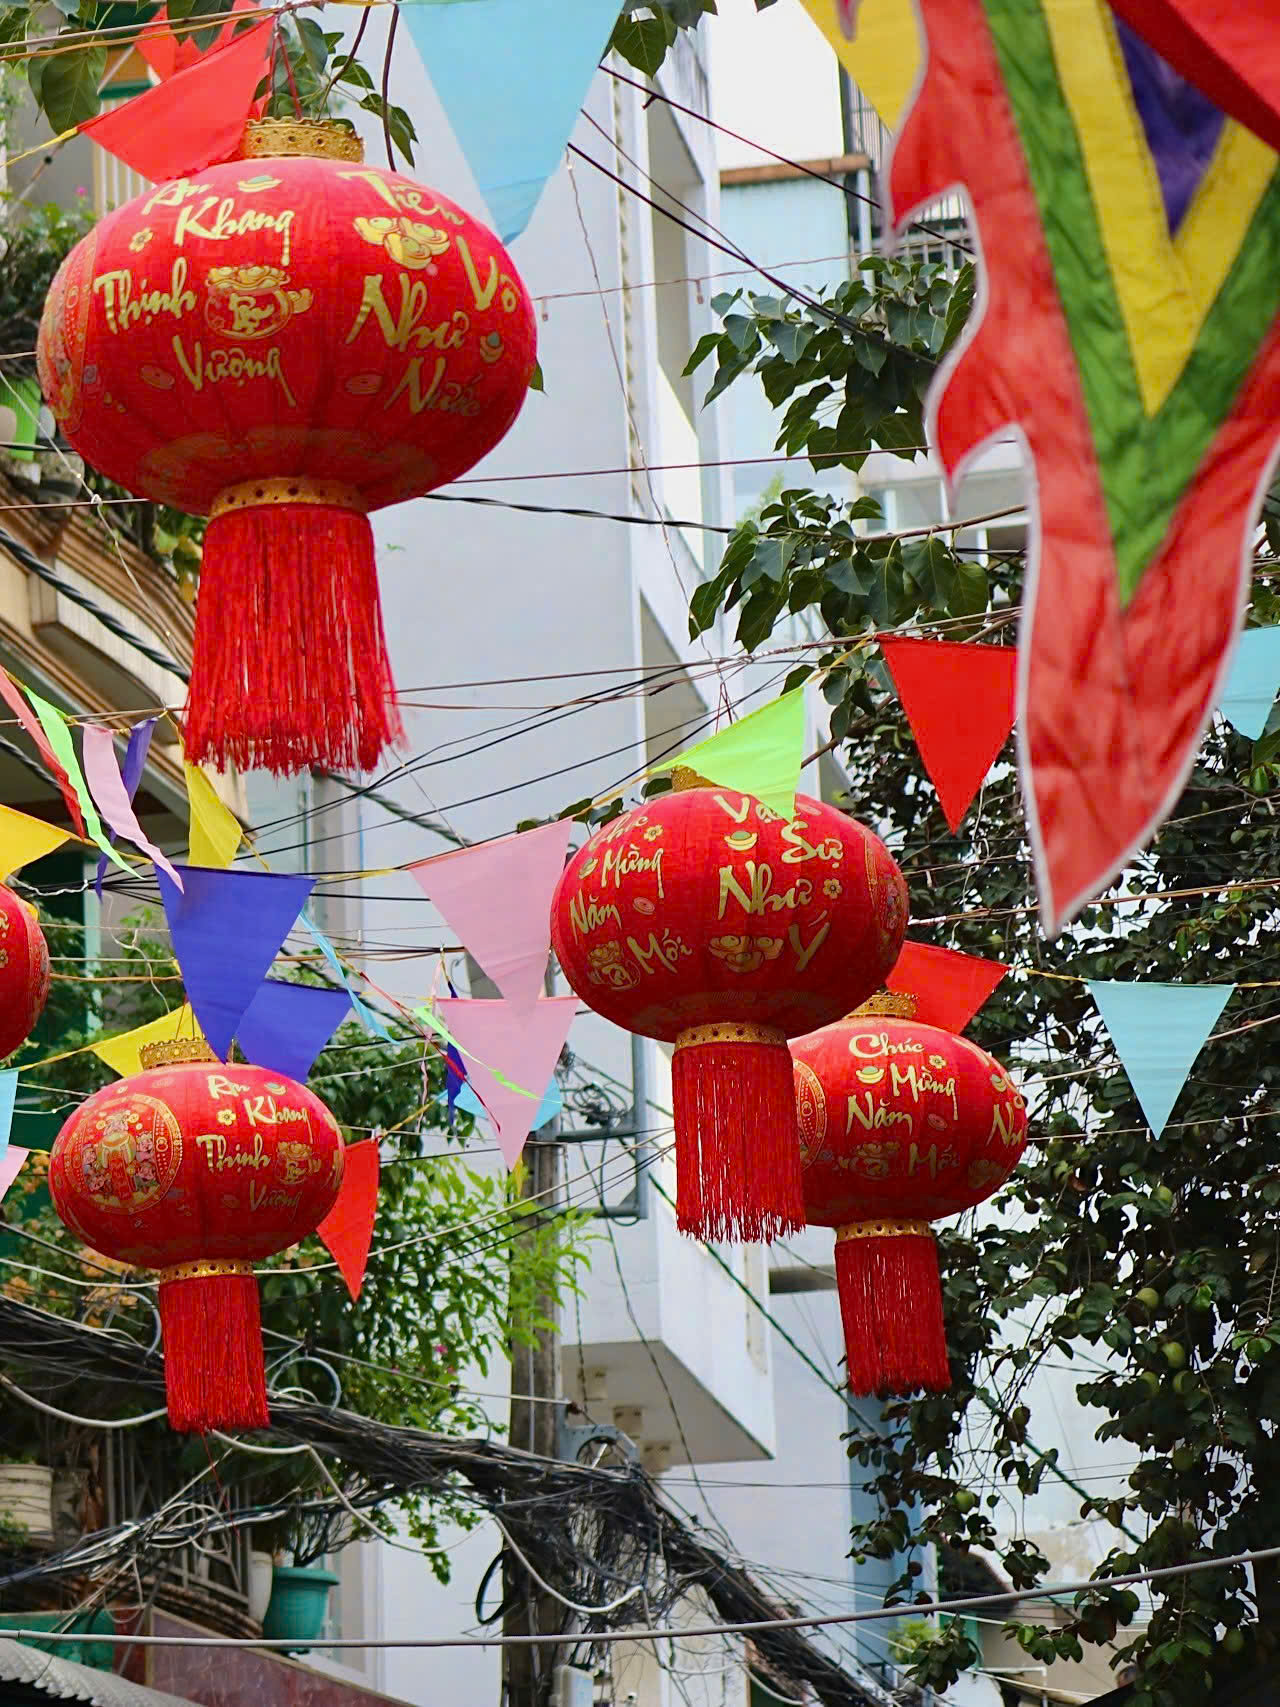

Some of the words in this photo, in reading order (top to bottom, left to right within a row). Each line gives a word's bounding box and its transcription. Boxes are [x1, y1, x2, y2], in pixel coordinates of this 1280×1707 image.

[141, 177, 214, 216] An
[173, 196, 295, 267] Khang
[93, 257, 198, 334] Thịnh
[456, 234, 524, 314] Vô
[346, 272, 471, 352] Như
[172, 335, 297, 407] Vượng
[713, 795, 786, 823] Vạ
[600, 843, 665, 899] Mừng
[781, 821, 844, 869] Sự
[569, 889, 622, 945] Năm
[718, 860, 813, 921] Như
[626, 928, 693, 974] Mới
[788, 909, 831, 973] Ý
[848, 1032, 925, 1059] Chúc
[244, 1096, 313, 1144] Khang
[845, 1091, 913, 1137] Năm
[890, 1063, 959, 1121] Mừng
[195, 1133, 271, 1173] Thịnh
